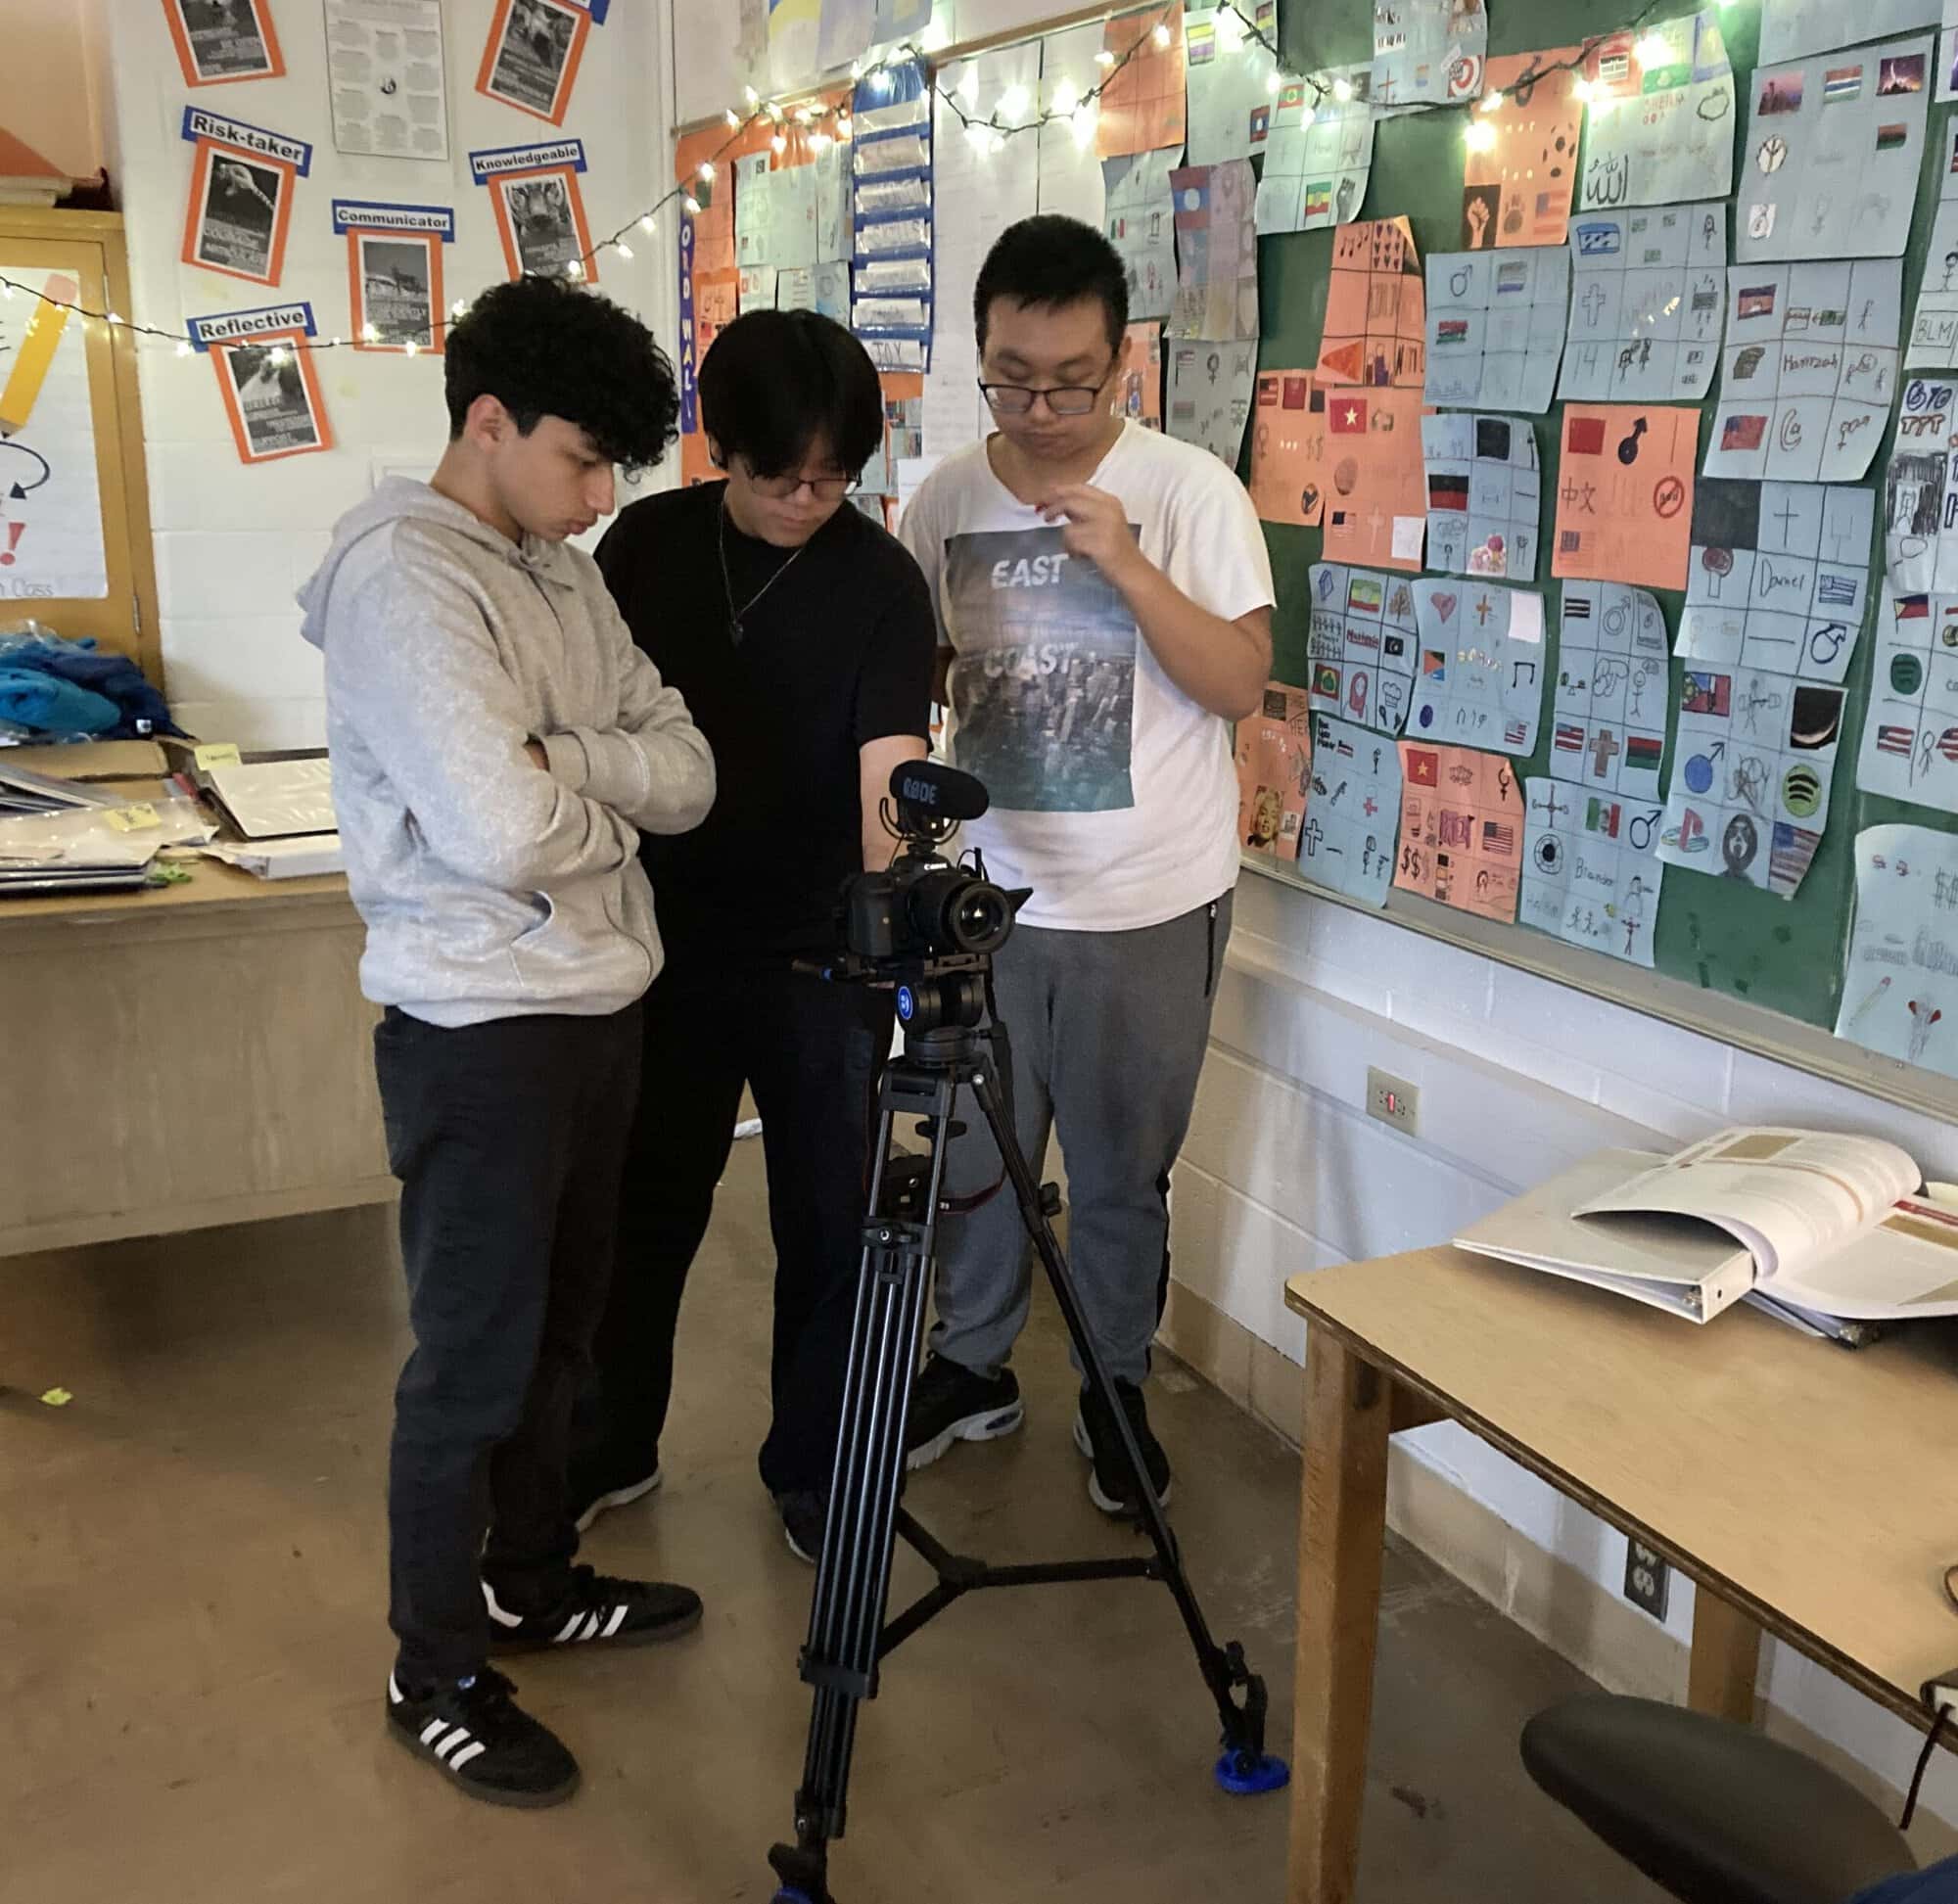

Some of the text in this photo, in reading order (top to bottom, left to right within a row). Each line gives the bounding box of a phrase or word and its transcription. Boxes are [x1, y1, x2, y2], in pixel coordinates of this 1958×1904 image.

[193, 115, 303, 161] Risk-taker
[476, 146, 578, 171] Knowledgeable
[338, 209, 448, 228] Communicator
[199, 310, 303, 338] Reflective
[1918, 318, 1952, 342] BLM
[1561, 477, 1597, 515] 中文
[991, 552, 1069, 589] EAST
[983, 641, 1079, 679] COAST
